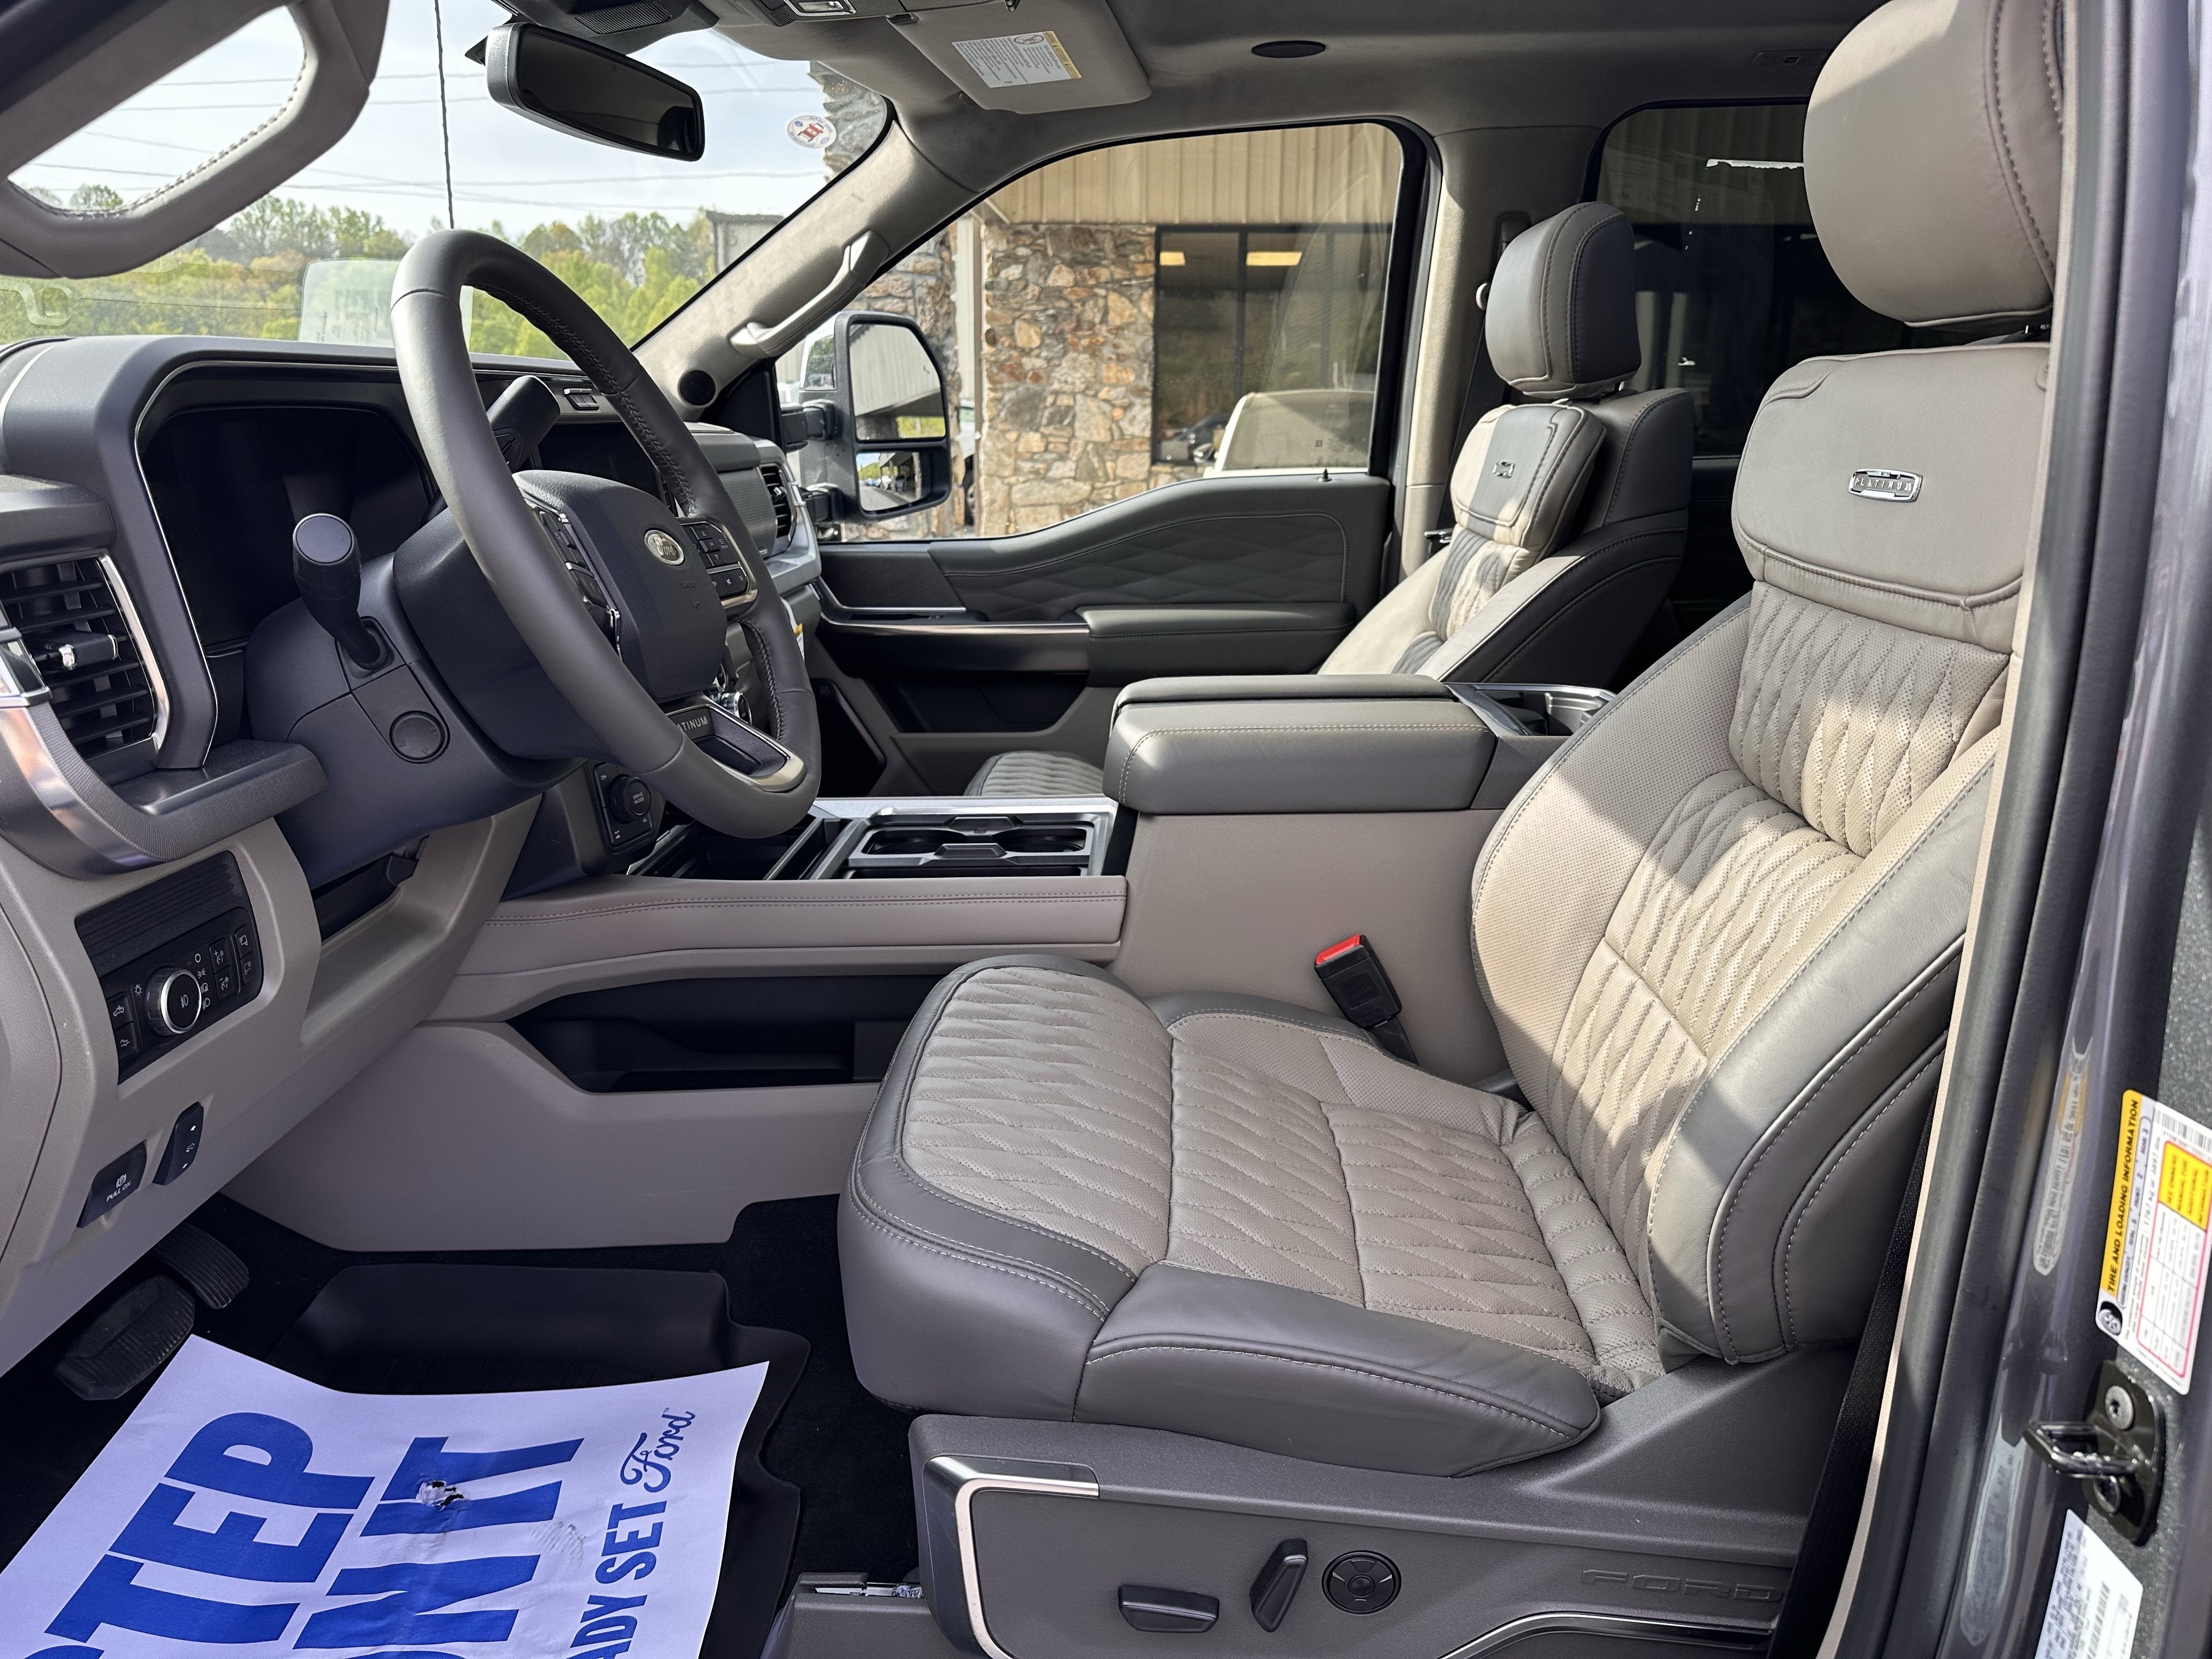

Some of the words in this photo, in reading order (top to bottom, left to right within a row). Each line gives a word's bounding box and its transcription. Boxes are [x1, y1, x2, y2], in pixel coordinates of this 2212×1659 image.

[1854, 477, 1912, 492] PLATINUM
[633, 792, 644, 800] DRIVE
[634, 796, 645, 805] MODE
[2121, 1099, 2138, 1182] INFORMATION
[106, 1188, 121, 1202] PULL
[122, 1180, 132, 1190] ON
[2115, 1184, 2128, 1237] LOADING
[2112, 1238, 2121, 1264] AND
[2107, 1265, 2118, 1291] TIRE
[620, 1408, 696, 1493] Ford
[359, 1436, 585, 1538] IT
[23, 1412, 376, 1659] TEP
[595, 1500, 668, 1584] SET
[293, 1554, 541, 1659] N
[1581, 1568, 1785, 1603] FORD
